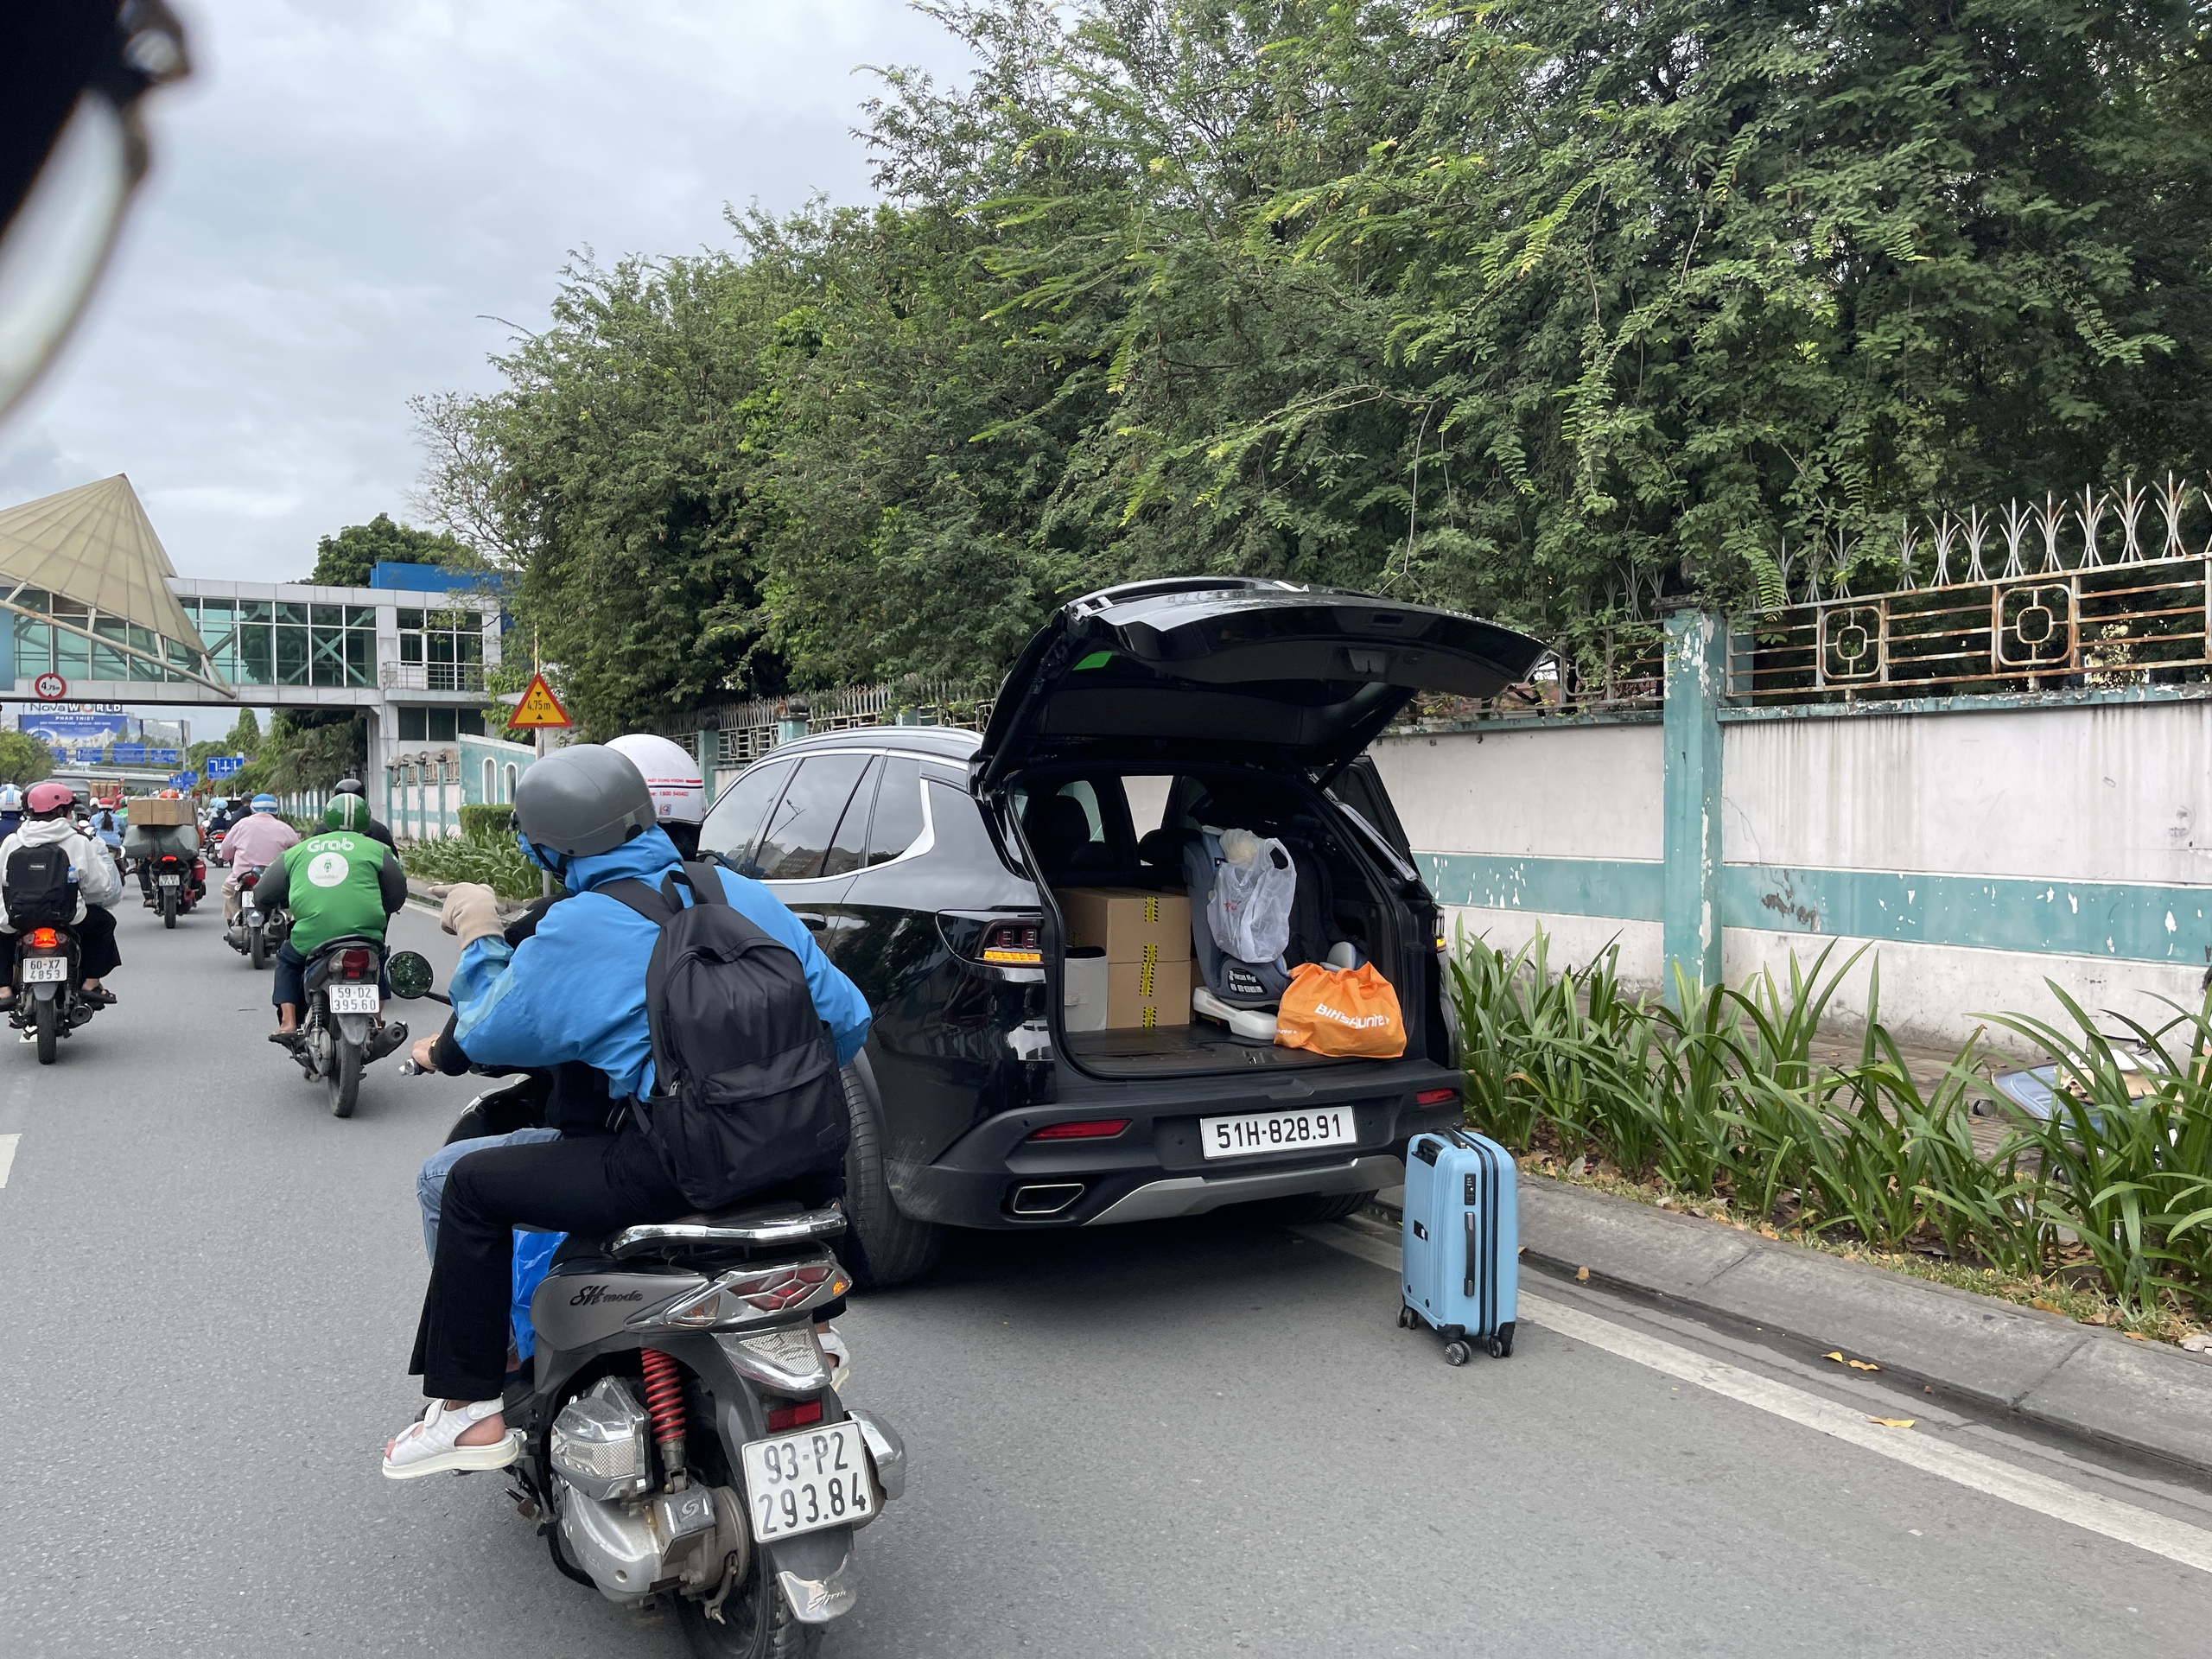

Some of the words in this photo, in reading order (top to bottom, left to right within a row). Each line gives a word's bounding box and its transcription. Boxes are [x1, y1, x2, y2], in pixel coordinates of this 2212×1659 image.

[307, 837, 355, 853] Grab
[30, 960, 60, 970] 60-X7
[30, 969, 60, 980] 4853
[334, 999, 376, 1011] 395.60
[1216, 1113, 1341, 1149] 51H-828.91
[763, 1431, 849, 1484] 93-P2
[758, 1472, 867, 1535] 293.84
